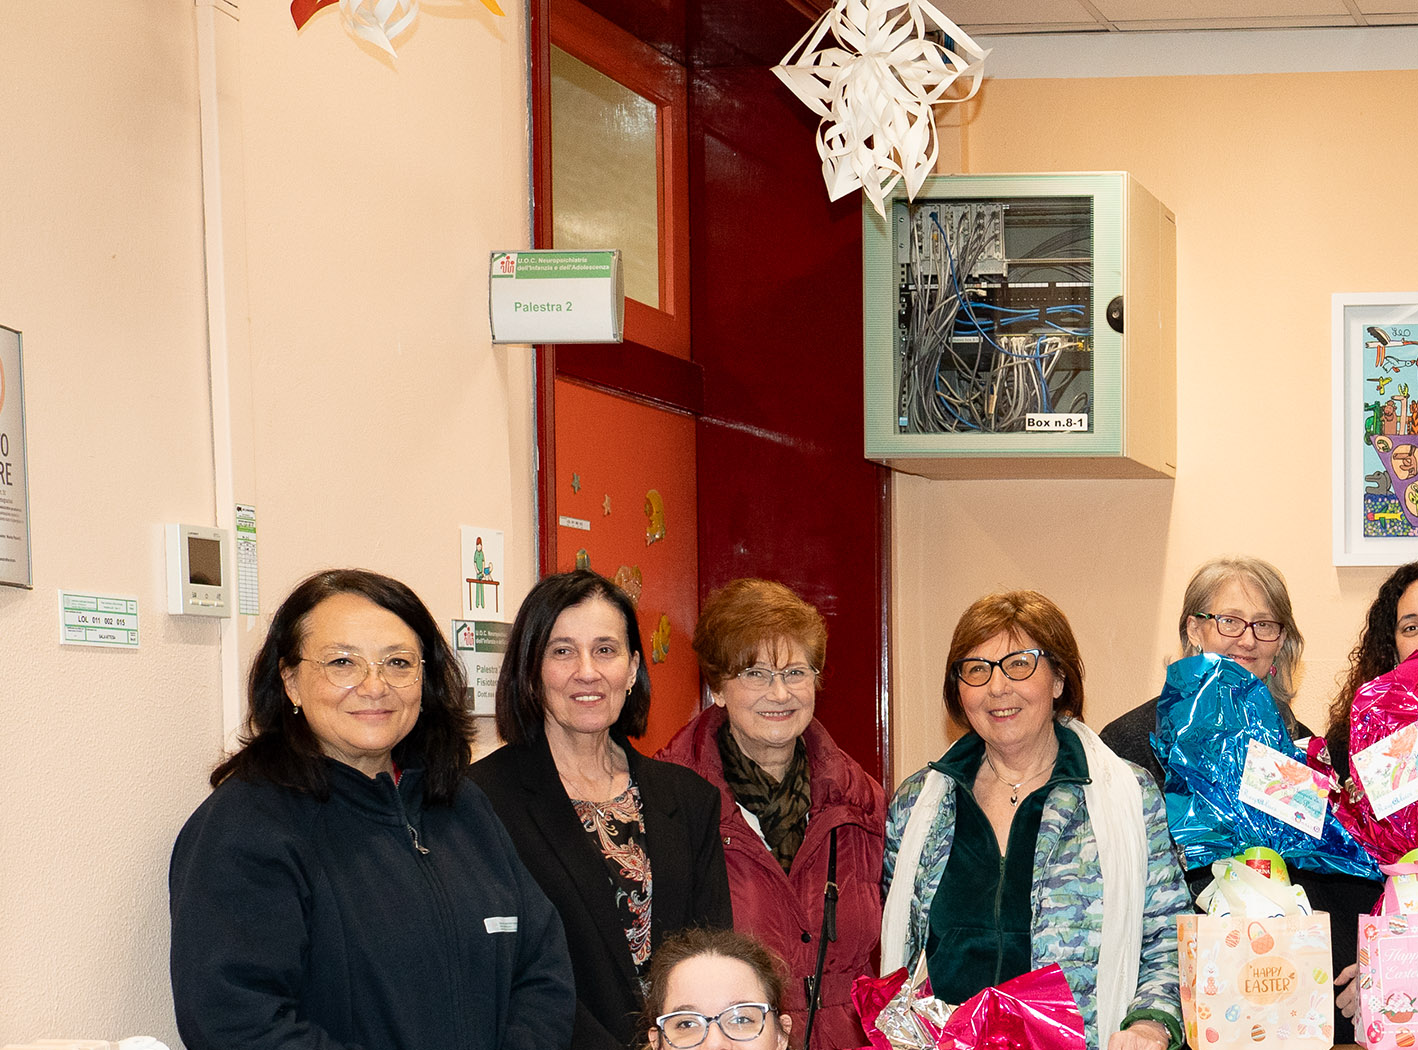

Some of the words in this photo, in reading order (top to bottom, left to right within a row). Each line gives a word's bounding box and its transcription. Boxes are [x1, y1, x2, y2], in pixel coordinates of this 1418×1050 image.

[514, 301, 562, 312] Palestra
[566, 301, 573, 312] 2
[1027, 418, 1051, 427] Box
[1054, 418, 1083, 427] n.8-1
[476, 664, 498, 674] Palestra
[1252, 966, 1282, 978] HAPPY
[1245, 978, 1291, 993] EASTER
